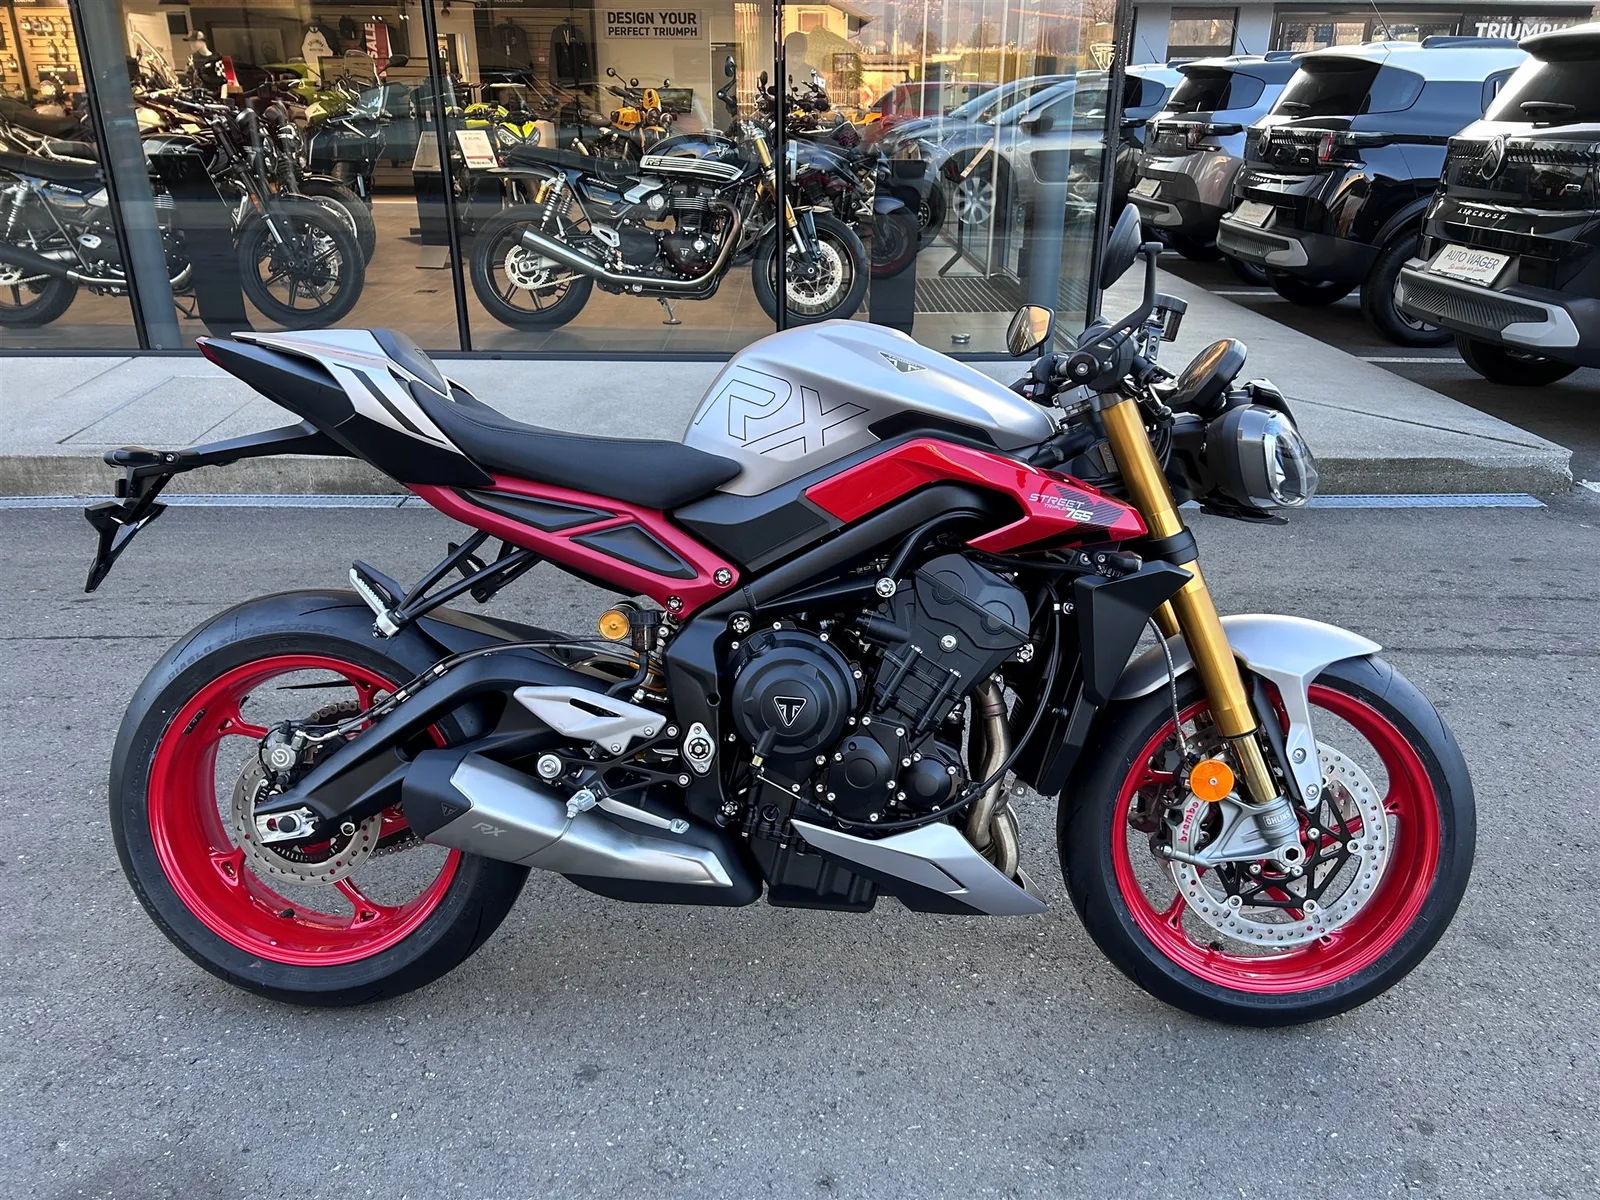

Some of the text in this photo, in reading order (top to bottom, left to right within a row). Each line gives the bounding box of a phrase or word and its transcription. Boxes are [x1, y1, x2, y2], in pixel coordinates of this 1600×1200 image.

[607, 12, 697, 25] DESIGN YOUR
[608, 26, 698, 37] PERFECT TRIUMPH
[364, 23, 379, 59] SALE
[645, 158, 662, 167] RS
[1457, 207, 1507, 220] AIRCROSS
[1443, 250, 1467, 262] AUTO
[694, 364, 871, 454] RX
[1028, 493, 1085, 509] STREET
[1044, 503, 1067, 511] TRIPLE
[1065, 508, 1094, 521] 765
[167, 643, 212, 682] DIABLO
[1178, 801, 1199, 843] brembo
[471, 821, 508, 838] RX
